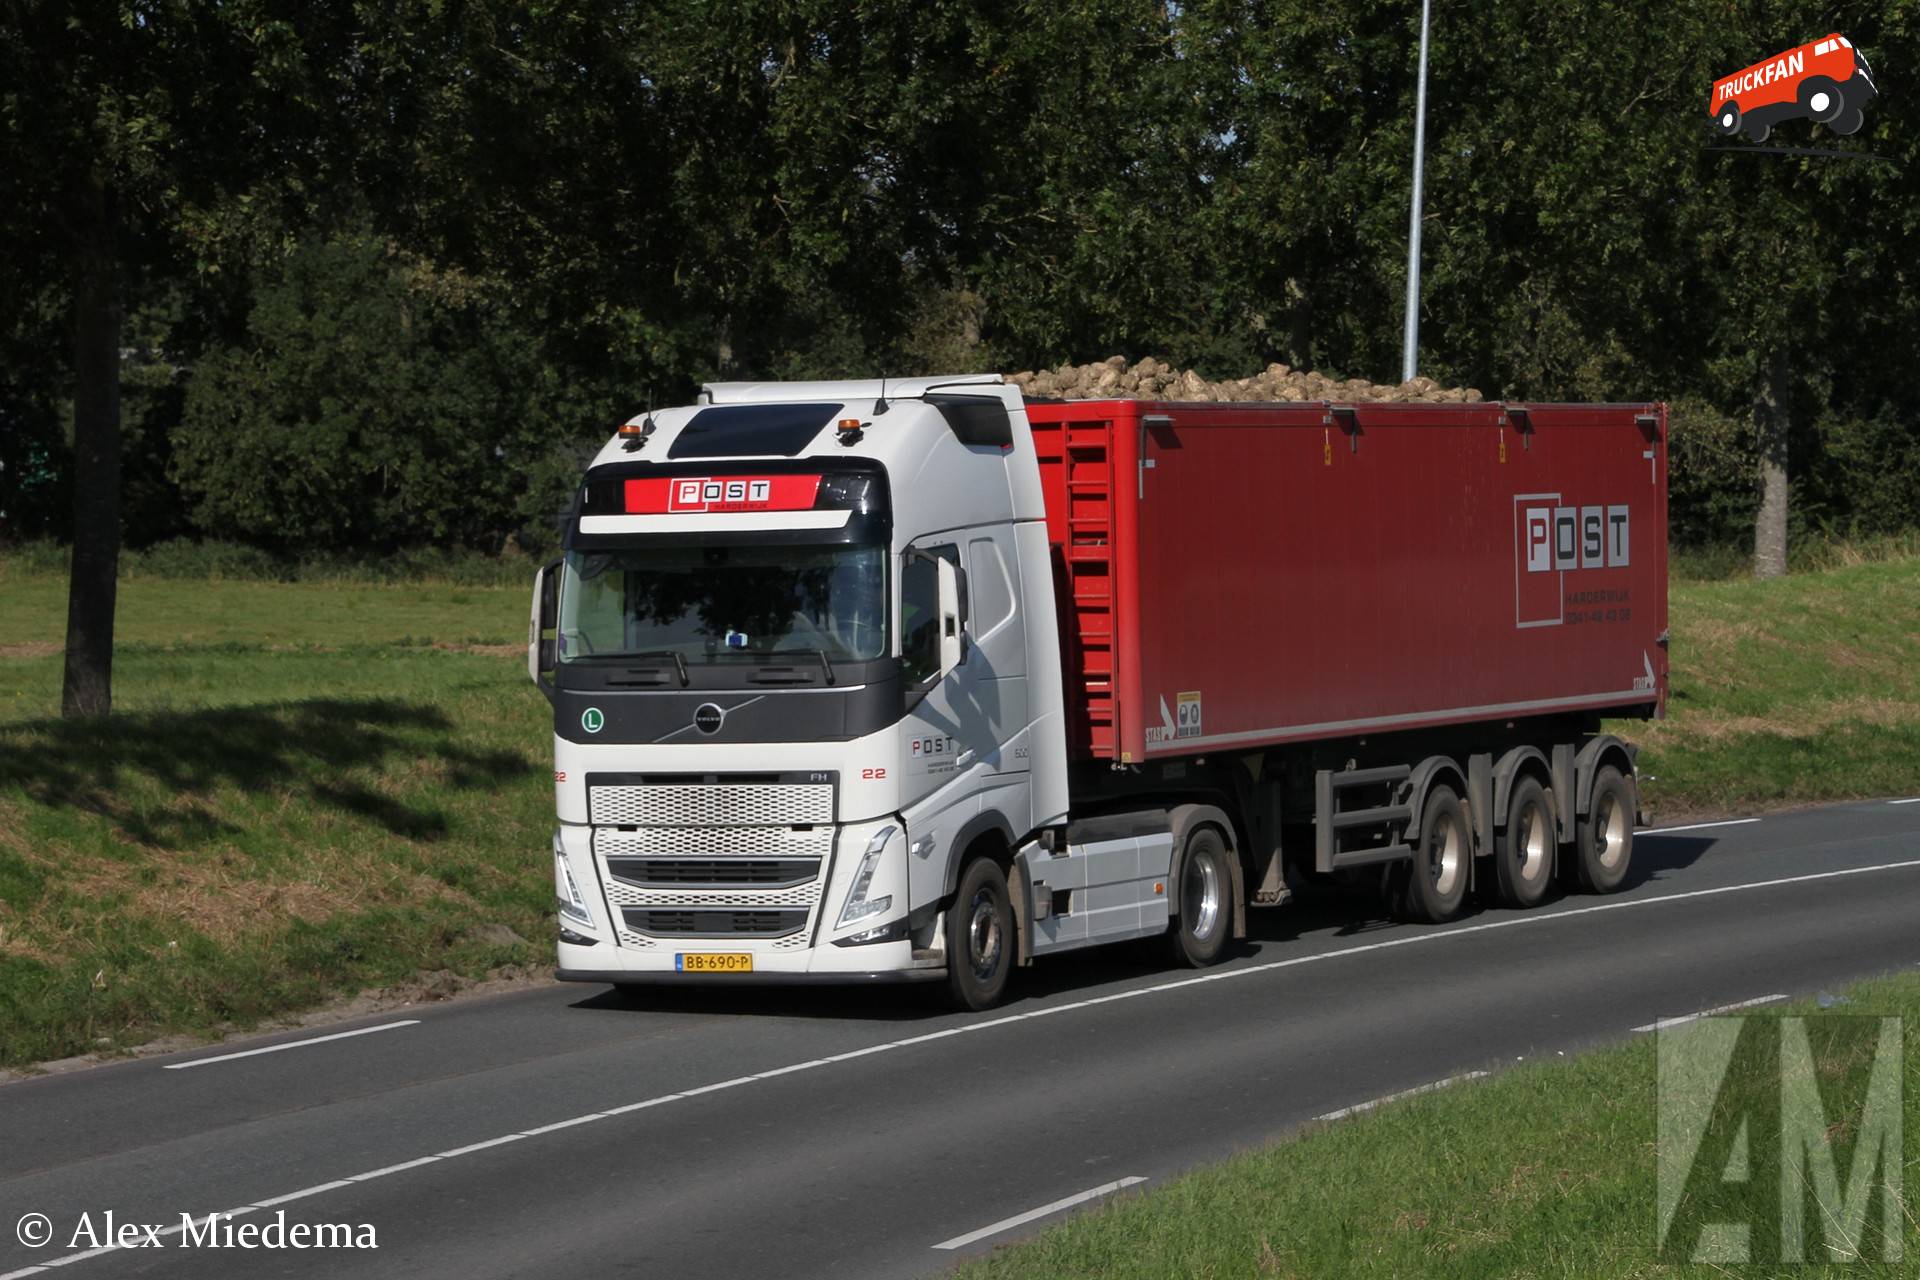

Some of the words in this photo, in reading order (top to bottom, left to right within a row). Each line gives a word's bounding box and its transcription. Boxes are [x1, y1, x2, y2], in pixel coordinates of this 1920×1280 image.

[682, 483, 768, 500] POST
[1529, 514, 1627, 562] POST
[1566, 590, 1631, 604] HARDERWIJK
[588, 713, 598, 728] L
[912, 737, 952, 755] POST
[810, 773, 827, 781] FH
[862, 768, 886, 779] 22
[686, 956, 748, 969] BB-690-P
